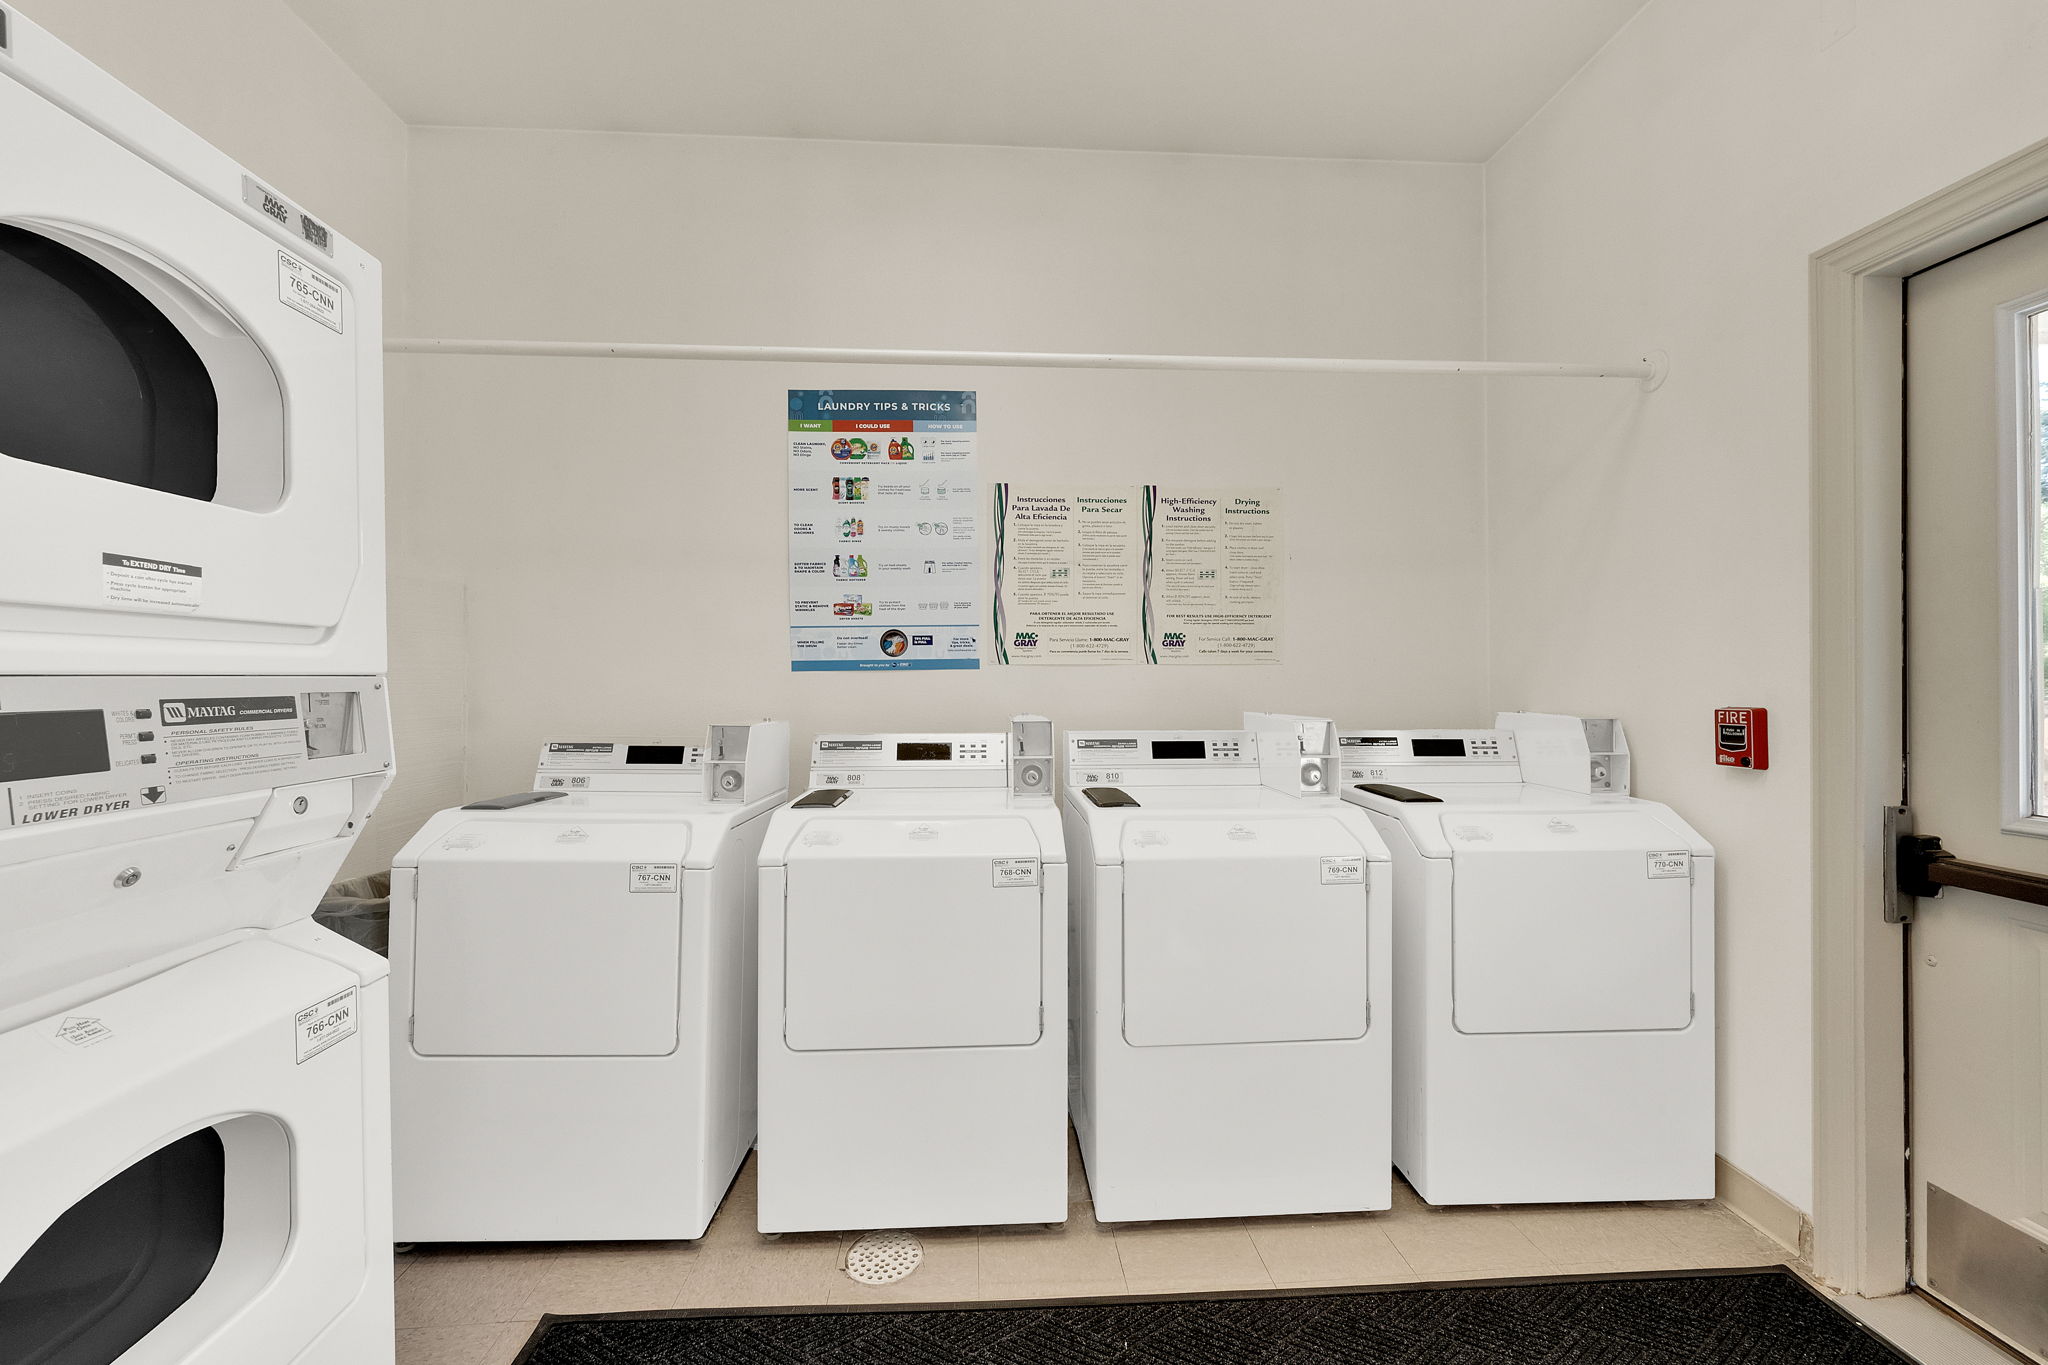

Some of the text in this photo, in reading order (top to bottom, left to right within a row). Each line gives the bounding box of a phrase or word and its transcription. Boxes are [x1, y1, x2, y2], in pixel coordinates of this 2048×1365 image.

[262, 202, 288, 224] GRAY
[280, 255, 298, 269] CSC
[290, 276, 334, 310] 765-CNN
[818, 402, 950, 411] LAUNDRY TIPS & TRICKS
[1161, 498, 1217, 506] High-Efficiency
[131, 560, 158, 570] EXTEND
[187, 706, 236, 718] MAYTAG
[1718, 711, 1747, 724] FIRE
[215, 754, 259, 762] INSTRUCTIONS
[80, 795, 103, 803] LOWER
[22, 800, 130, 824] LOWER DRYER
[306, 1007, 349, 1038] 766-CNN
